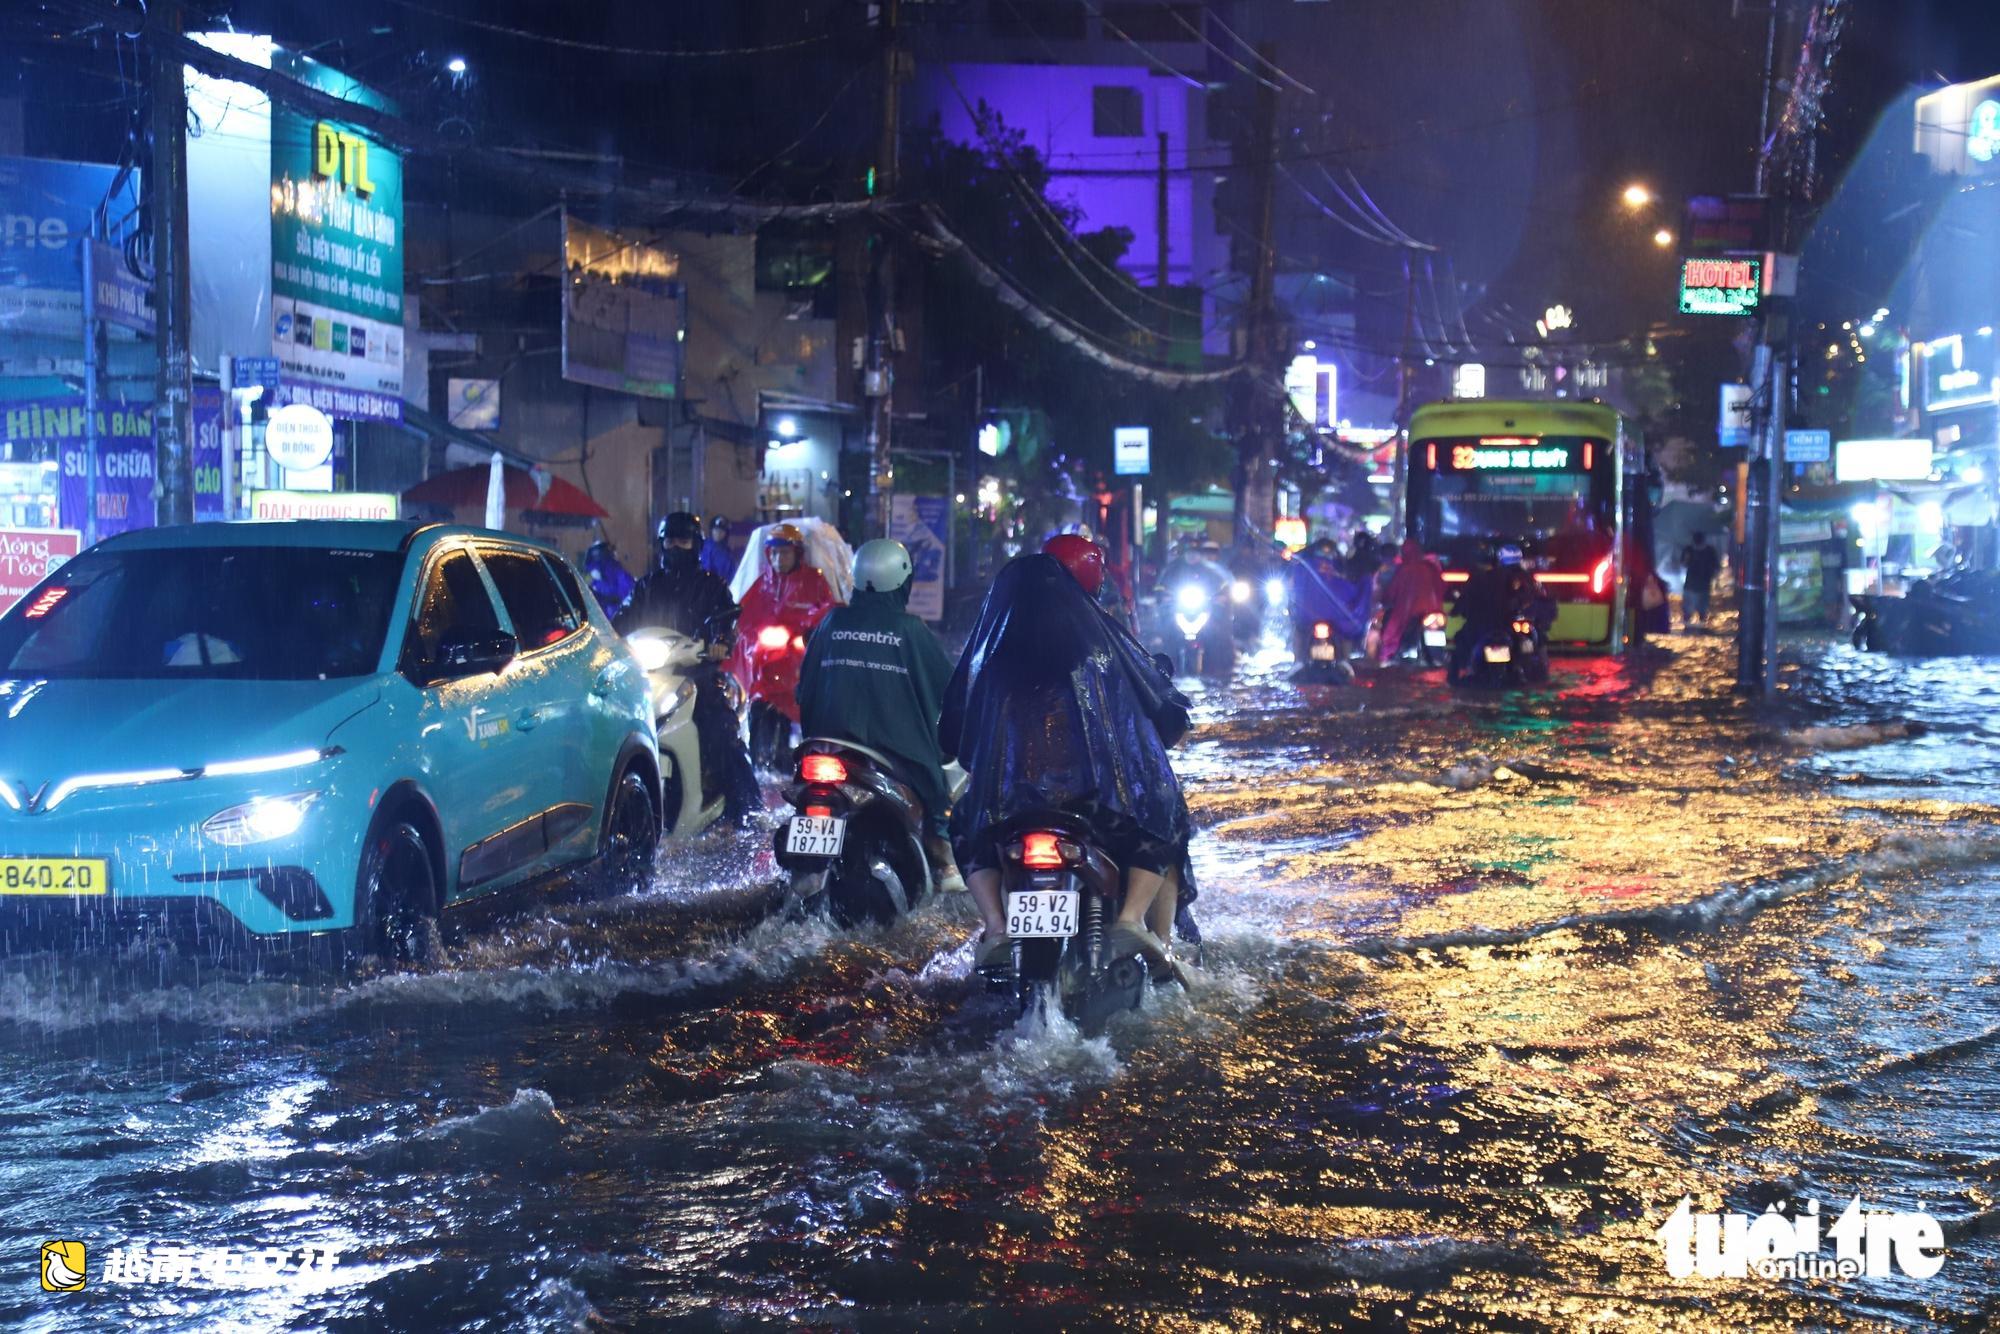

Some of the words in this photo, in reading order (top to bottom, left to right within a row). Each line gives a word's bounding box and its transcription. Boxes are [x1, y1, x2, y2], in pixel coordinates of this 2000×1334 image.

[317, 122, 376, 193] DTL
[0, 214, 69, 250] ne
[1686, 262, 1755, 289] HOTEL
[98, 279, 119, 310] KHU
[112, 408, 151, 437] BÁN
[105, 449, 152, 478] CHỮA
[1453, 446, 1476, 469] 32
[1, 555, 45, 577] Tóc
[831, 629, 902, 647] concentrix
[866, 662, 881, 671] one
[792, 835, 838, 854] 187.17
[1018, 895, 1068, 913] 59-V2
[1010, 915, 1072, 933] 964.94
